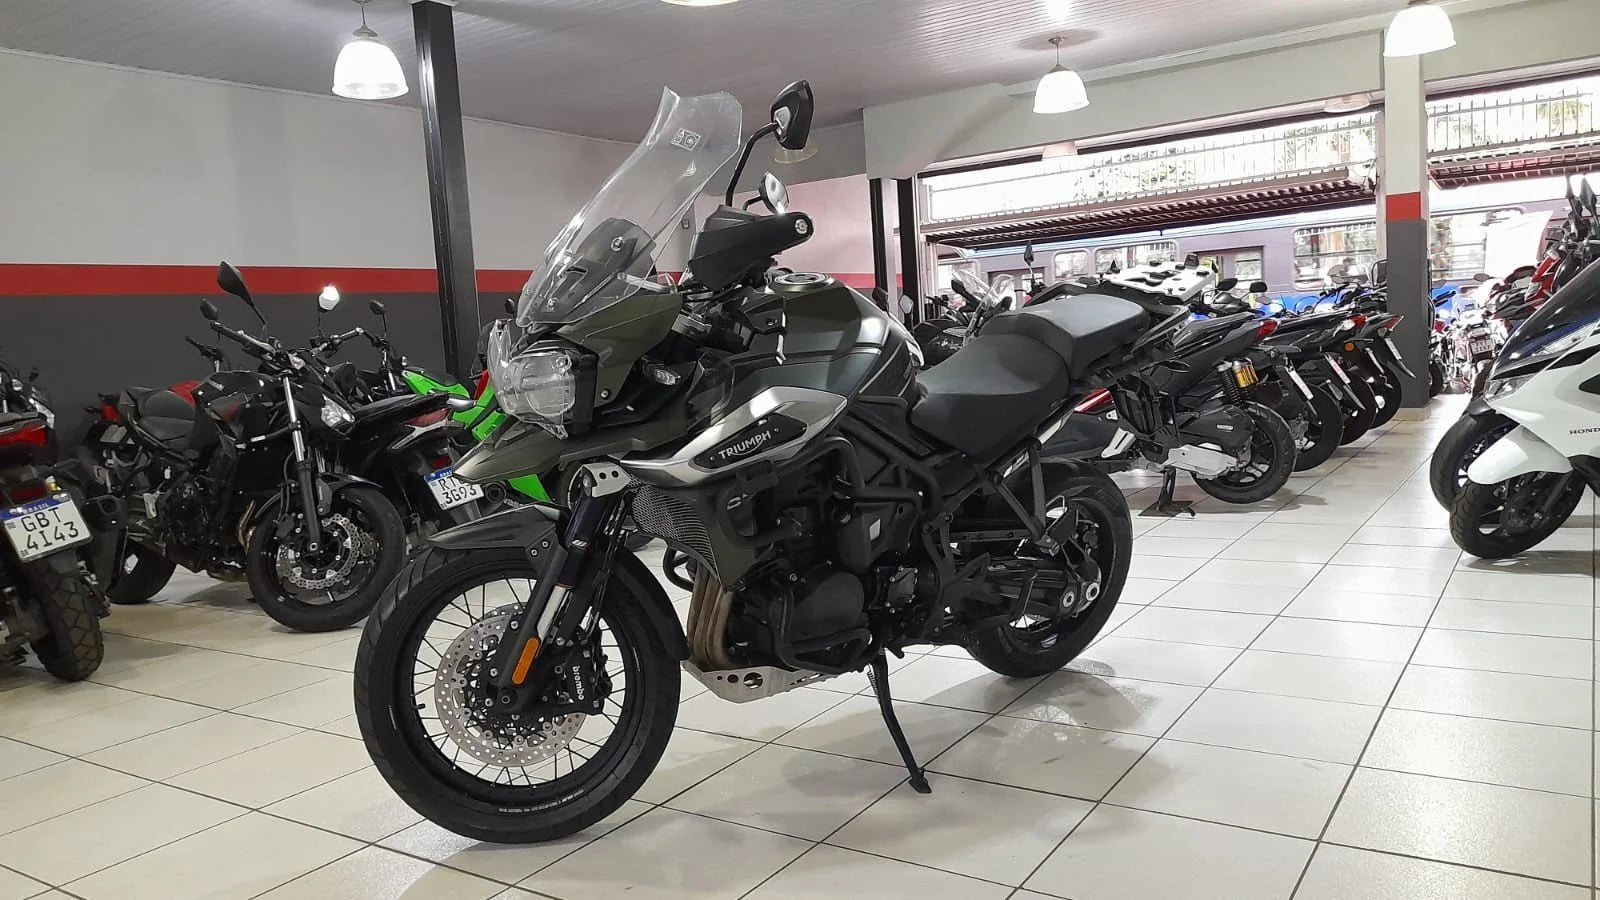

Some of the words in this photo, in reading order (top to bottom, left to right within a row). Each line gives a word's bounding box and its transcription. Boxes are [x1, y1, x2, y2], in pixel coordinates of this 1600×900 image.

[1569, 427, 1600, 435] HOND
[718, 430, 772, 459] TRIUMPH
[439, 476, 460, 491] RT
[442, 484, 477, 504] 3G93
[21, 507, 61, 532] GBT
[27, 521, 79, 550] 4I43
[572, 665, 585, 700] brembo
